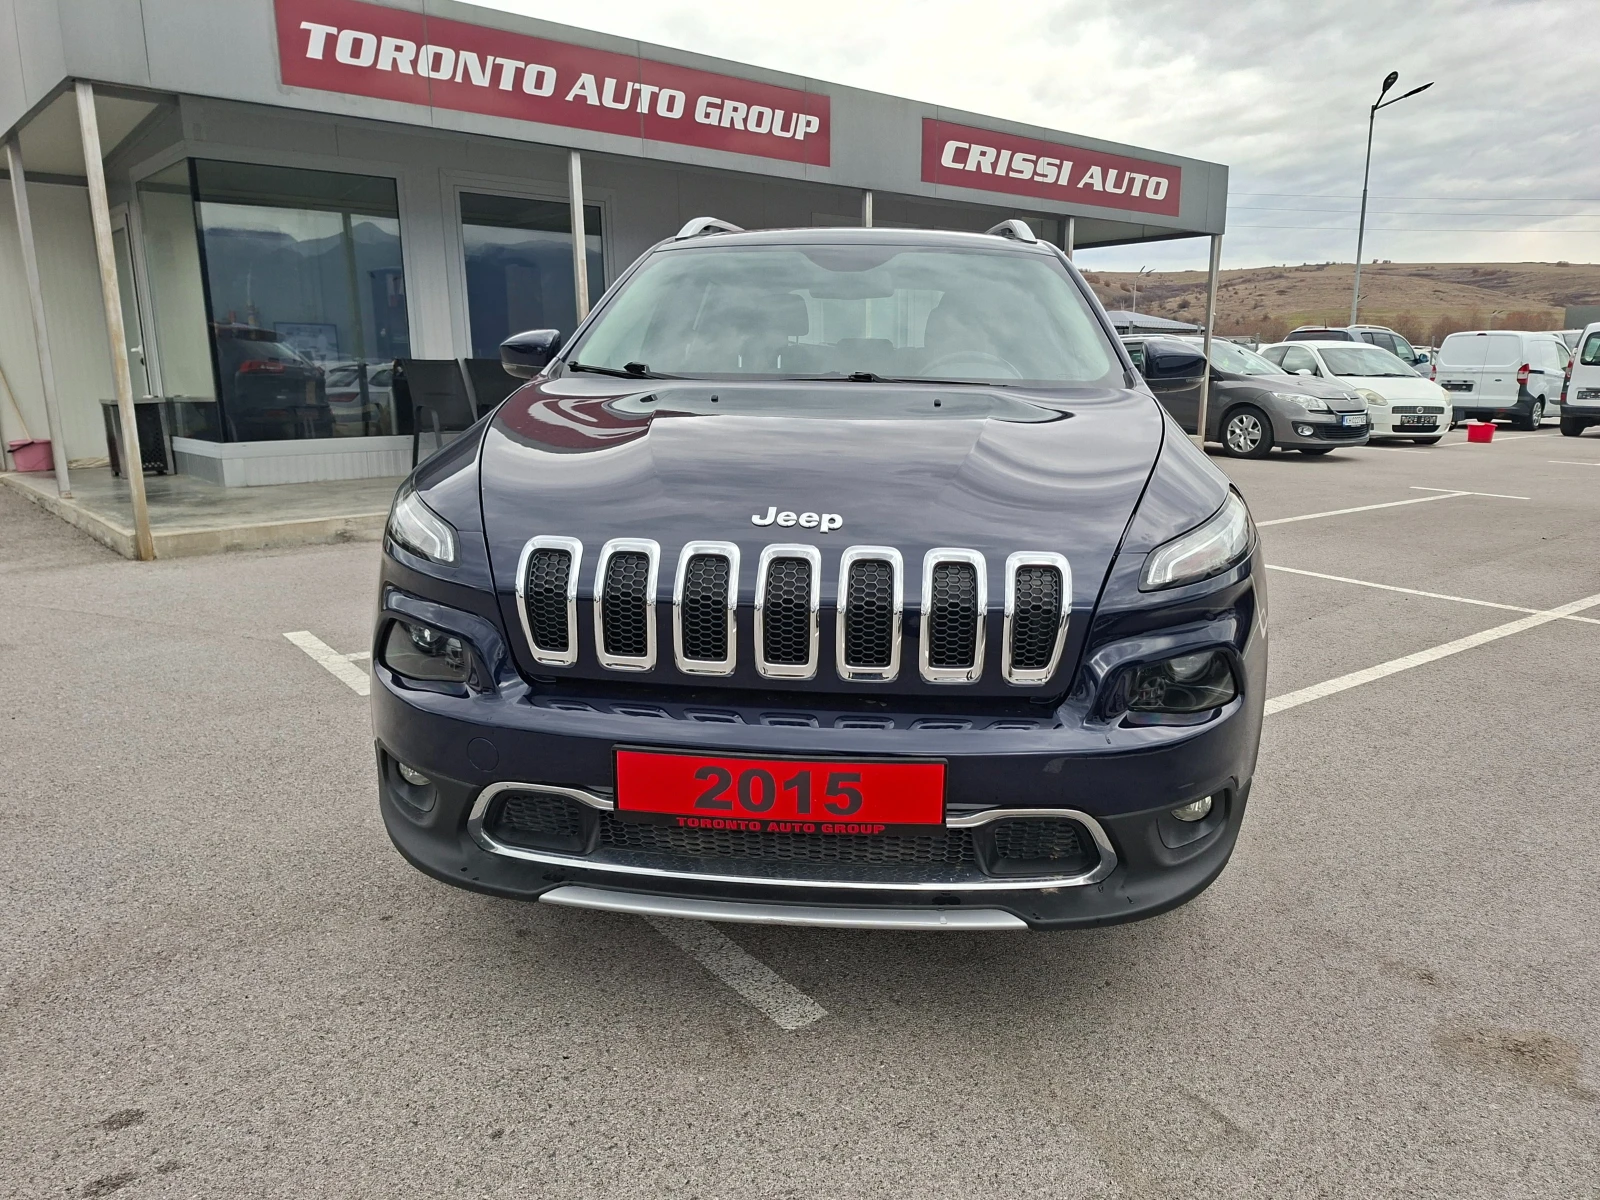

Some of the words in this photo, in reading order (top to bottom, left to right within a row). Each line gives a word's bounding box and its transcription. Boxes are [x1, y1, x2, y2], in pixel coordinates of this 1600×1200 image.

[300, 21, 557, 98] TORONTO
[565, 73, 686, 119] AUTO
[694, 95, 820, 141] GROUP
[940, 140, 1074, 185] CRISSI
[1077, 165, 1169, 200] AUTO
[751, 506, 843, 534] Jeep
[693, 765, 864, 816] 2015
[676, 817, 761, 832] TORONTO
[767, 821, 816, 833] AUTO
[821, 823, 886, 834] GROUP
